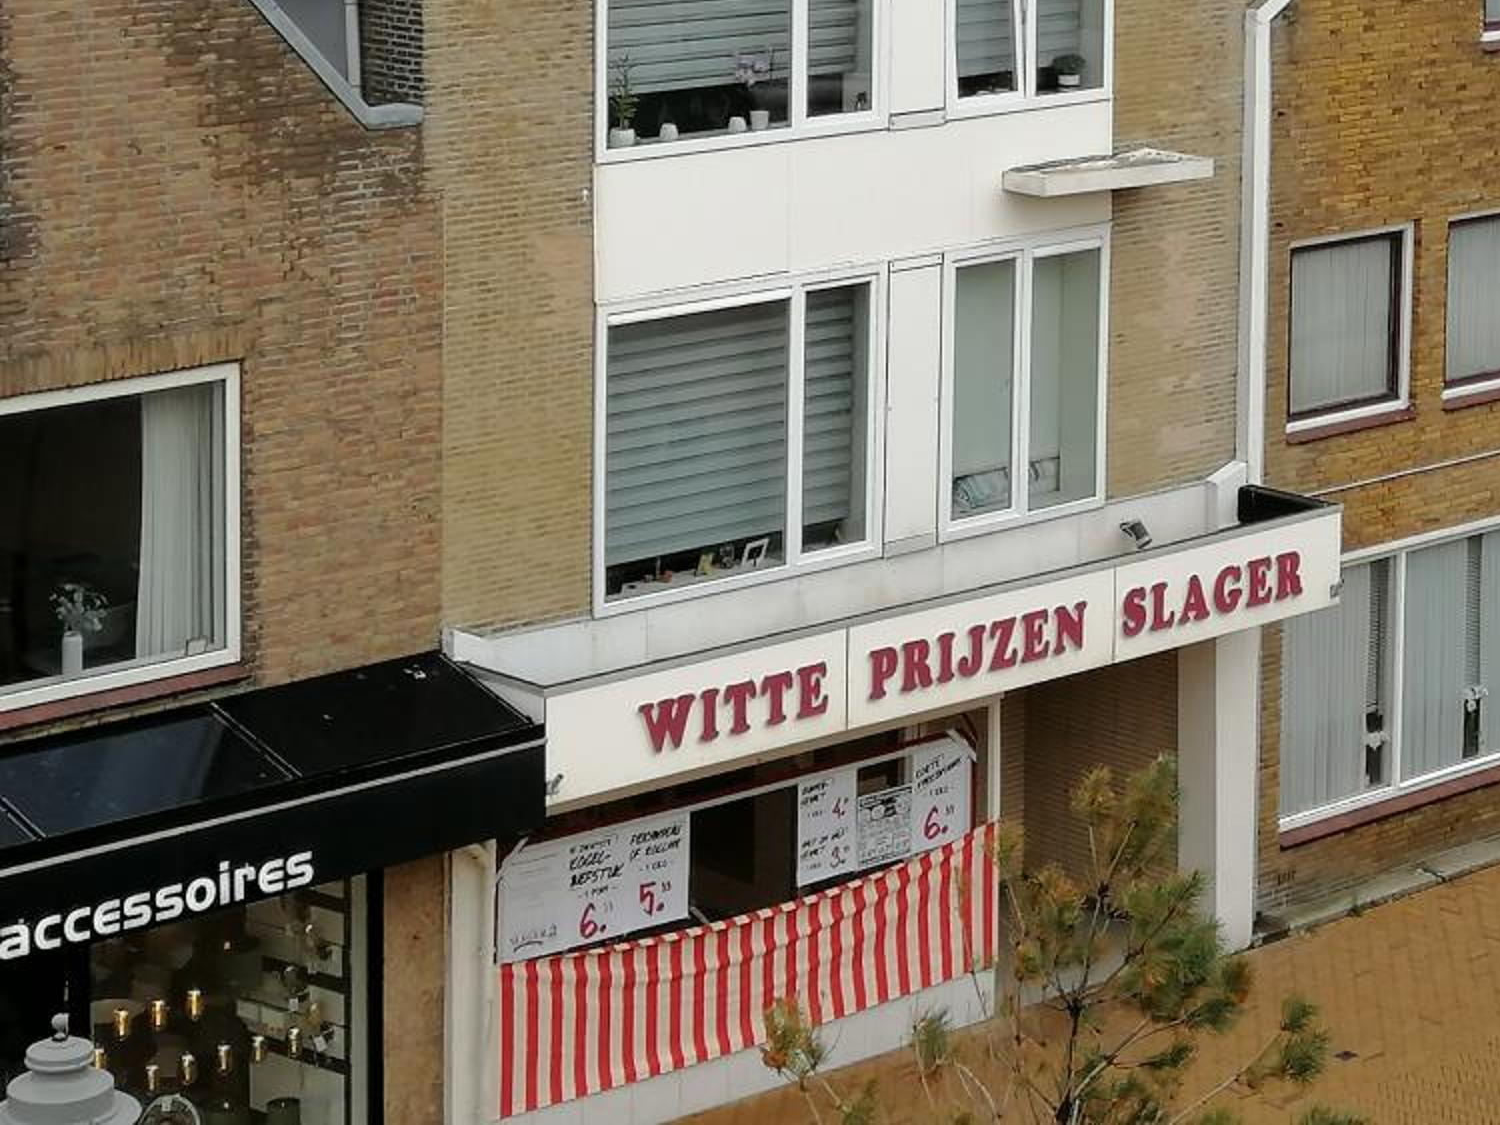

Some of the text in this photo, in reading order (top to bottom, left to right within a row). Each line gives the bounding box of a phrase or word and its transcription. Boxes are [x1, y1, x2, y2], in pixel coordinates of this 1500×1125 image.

[639, 551, 1303, 753] WITTE PRIJZEN SLAGER
[0, 850, 314, 961] accessoires
